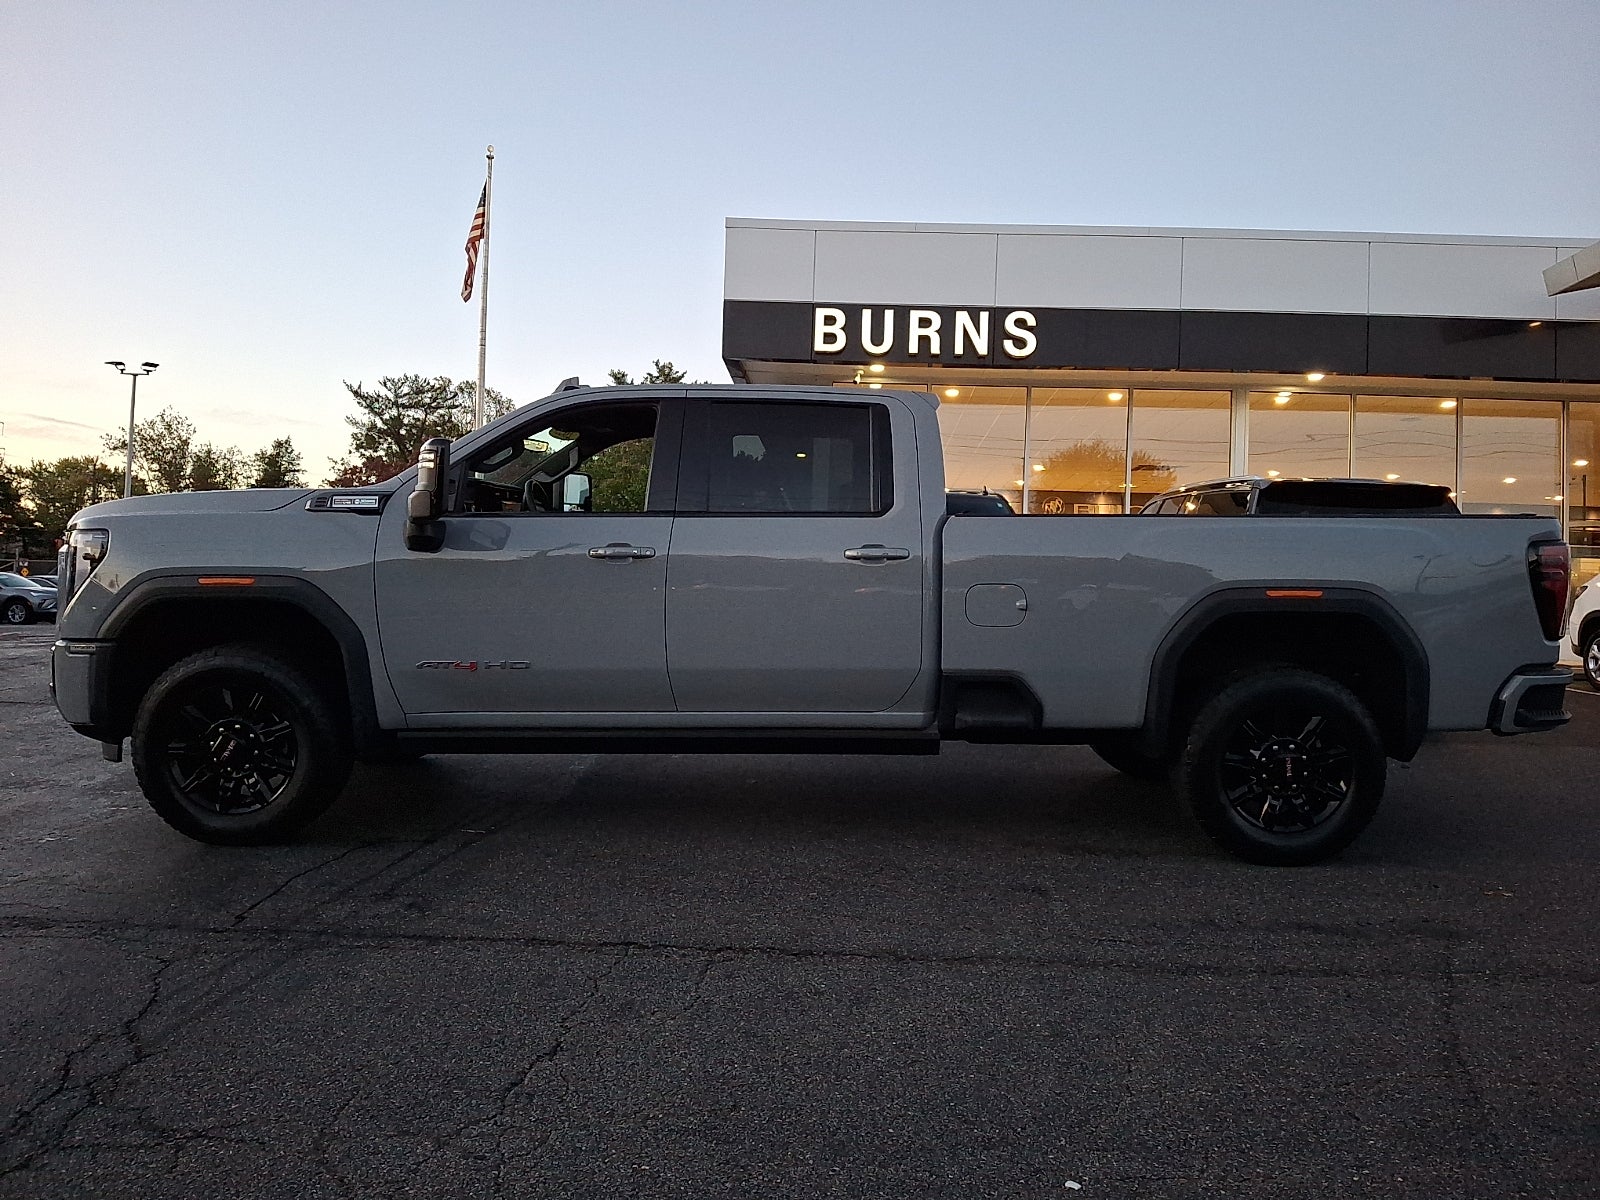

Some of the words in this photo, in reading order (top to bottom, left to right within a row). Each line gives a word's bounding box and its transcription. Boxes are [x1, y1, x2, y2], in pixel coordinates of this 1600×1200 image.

[814, 307, 1037, 358] BURNS
[415, 660, 478, 671] AT4
[484, 660, 531, 670] HD
